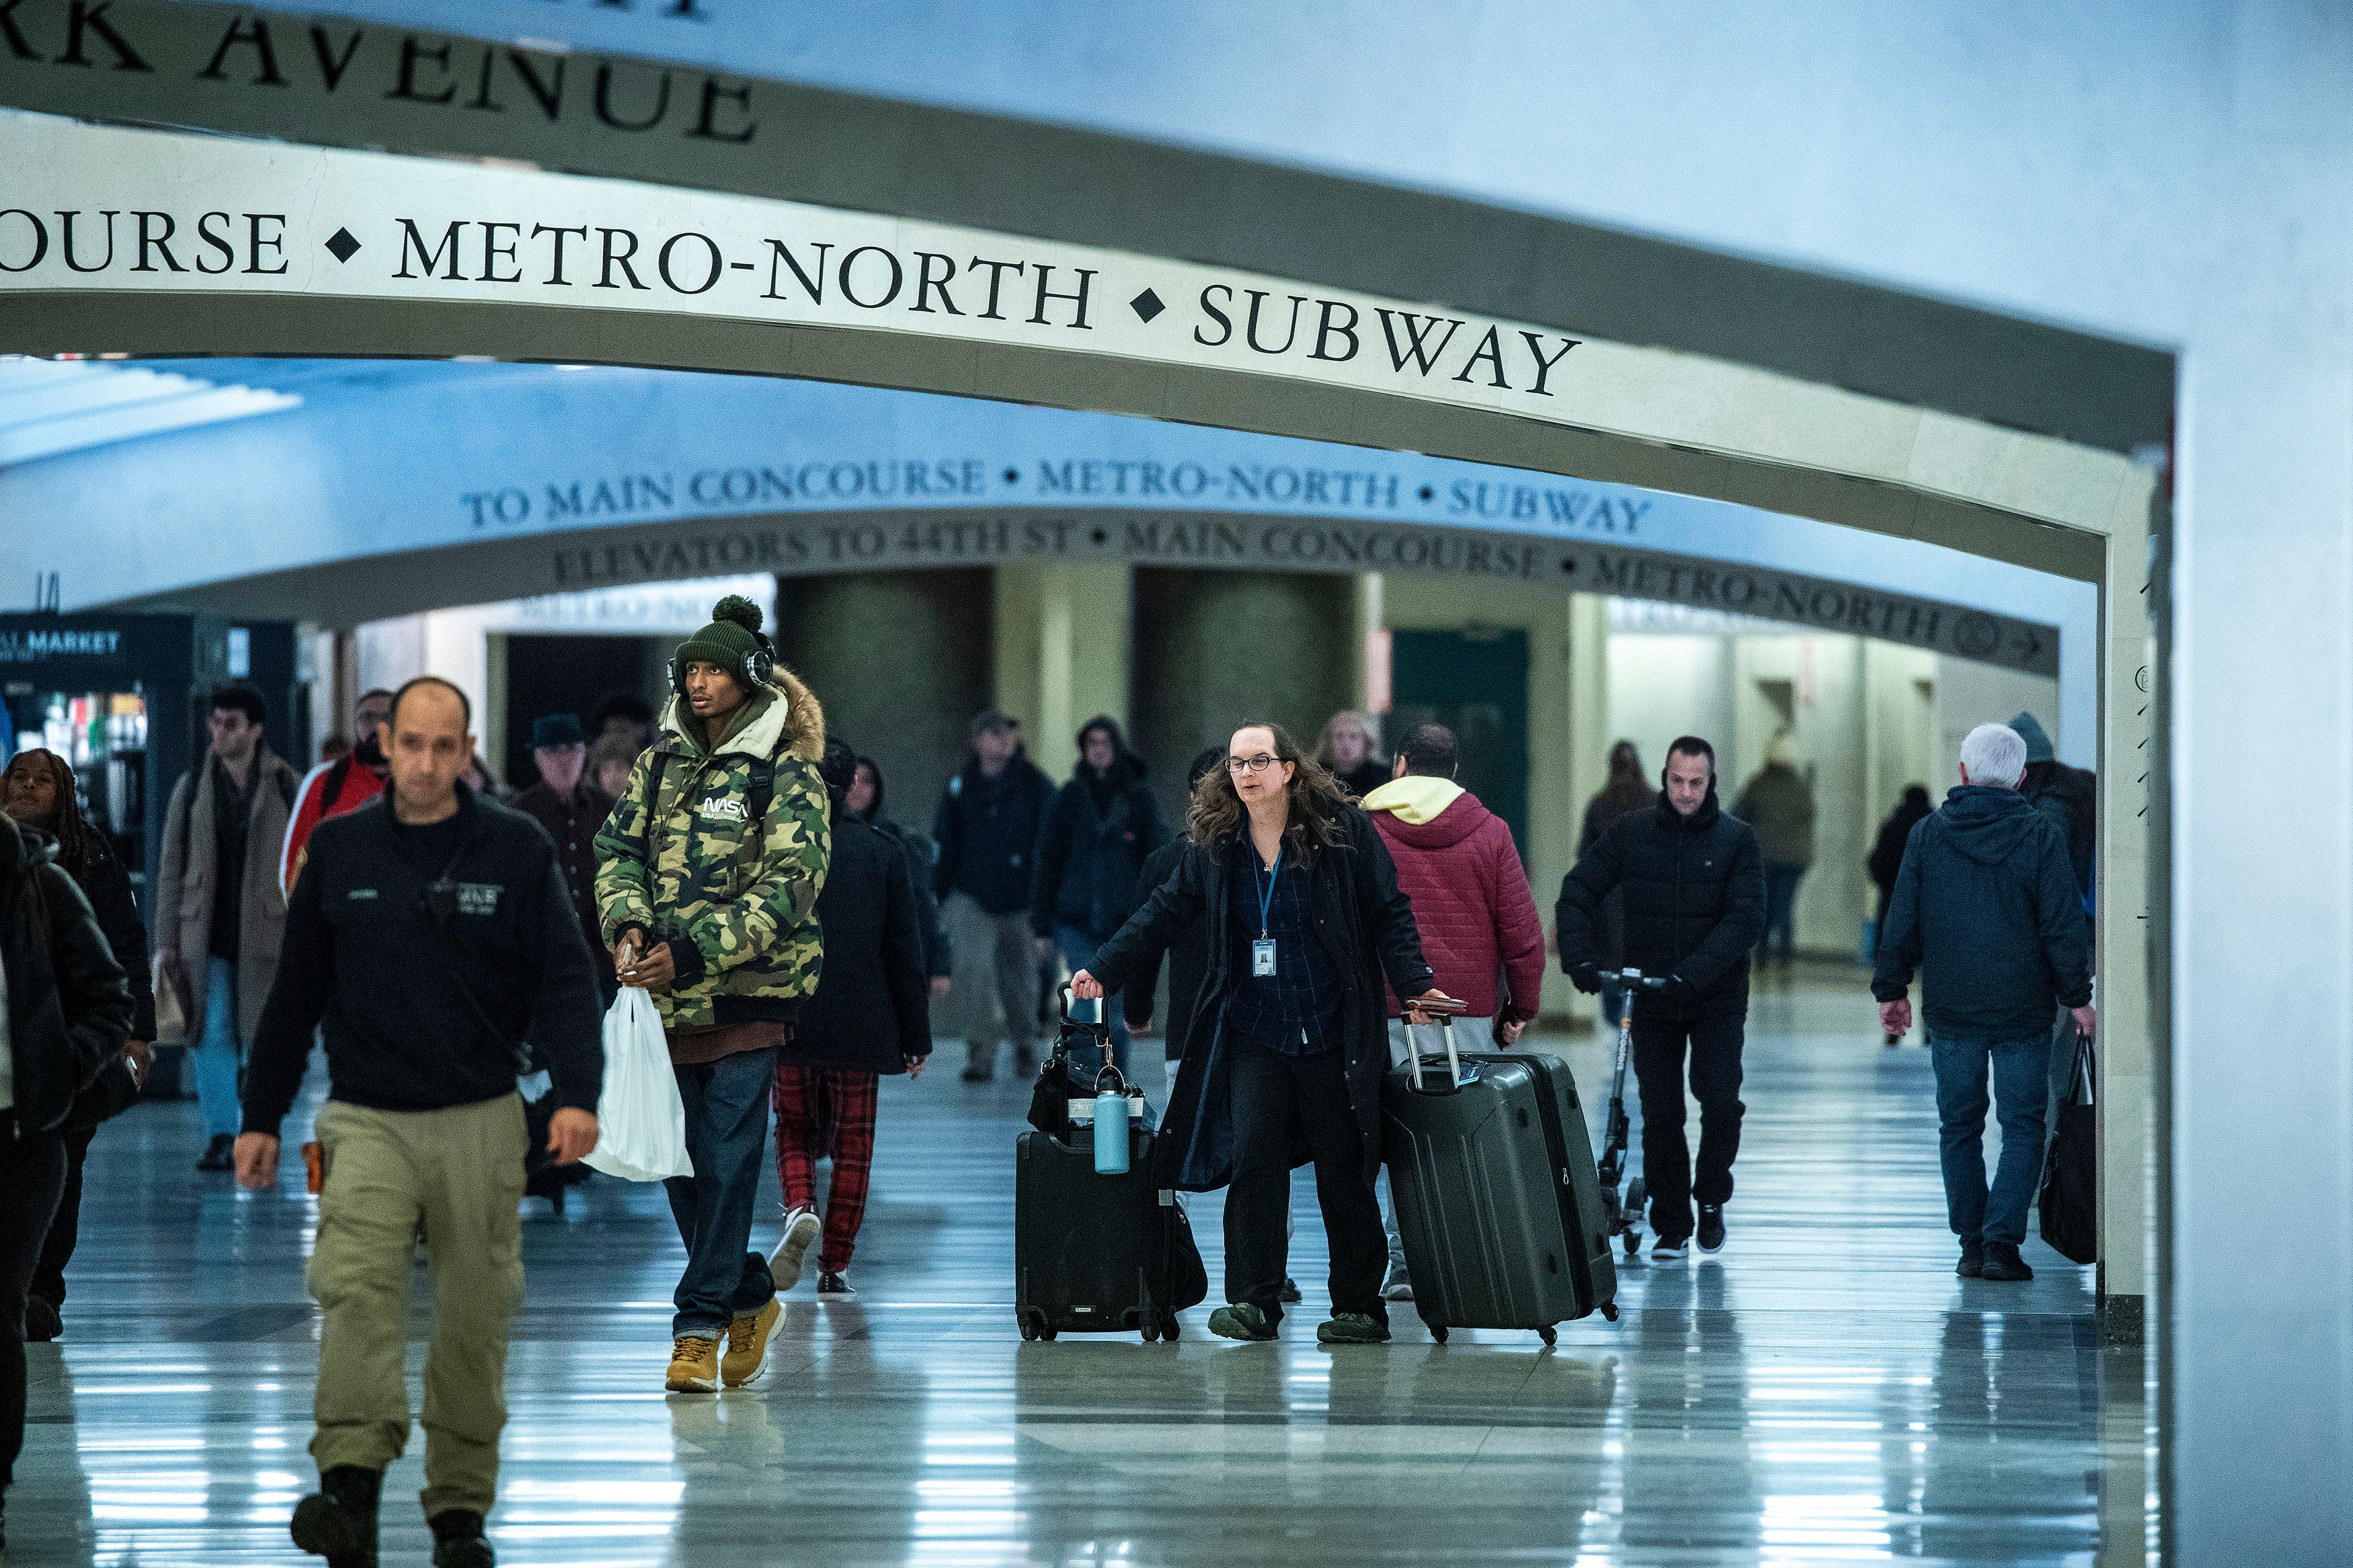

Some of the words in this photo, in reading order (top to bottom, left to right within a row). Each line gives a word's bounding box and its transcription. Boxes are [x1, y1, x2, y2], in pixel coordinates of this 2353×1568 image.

[196, 10, 759, 143] AVENUE
[0, 209, 290, 275] OURSE
[391, 218, 1099, 330] METRO-NORTH
[1194, 284, 1583, 396] SUBWAY
[461, 487, 531, 527] TO
[544, 474, 674, 520] MAIN
[688, 459, 986, 504] CONCOURSE
[1037, 459, 1399, 509] METRO-NORTH
[1447, 477, 1650, 534] SUBWAY
[1124, 520, 1245, 556] MAIN
[1260, 524, 1544, 579] CONCOURSE
[1595, 554, 1940, 643] METRO-NORTH
[28, 630, 120, 653] MARKET
[703, 797, 748, 817] NASA
